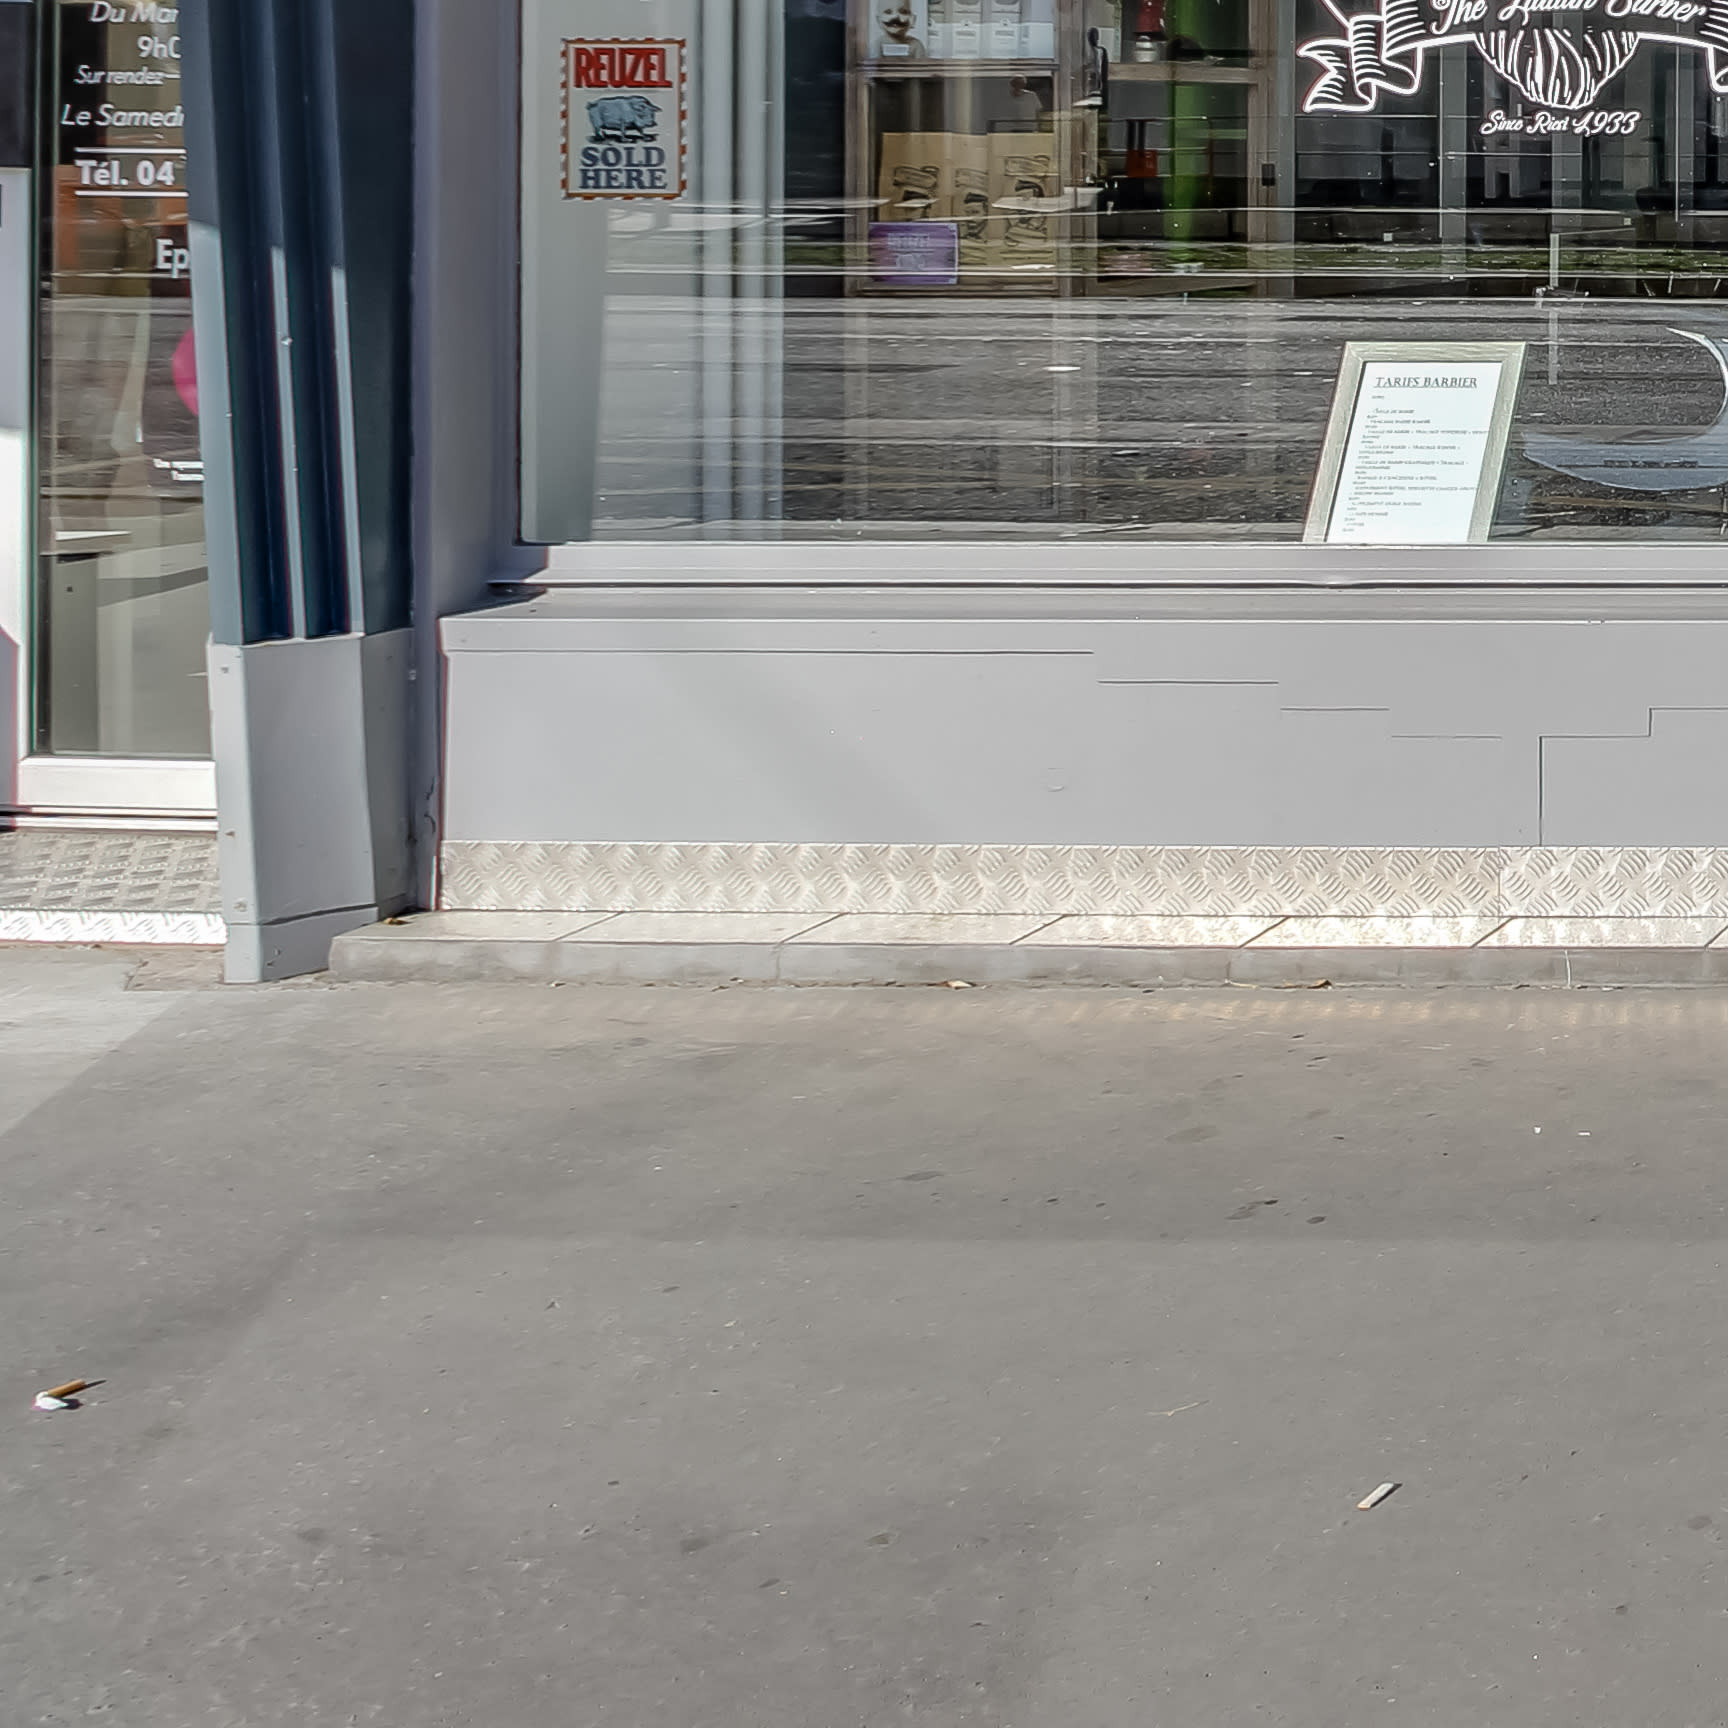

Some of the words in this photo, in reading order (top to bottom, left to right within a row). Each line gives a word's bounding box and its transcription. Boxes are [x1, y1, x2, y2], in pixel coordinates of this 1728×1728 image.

[90, 1, 125, 22] Du
[74, 64, 104, 84] Sur
[573, 47, 673, 88] REUZEL
[61, 104, 91, 126] Le
[581, 146, 665, 168] SOLD
[74, 159, 129, 186] Tél.
[136, 159, 175, 186] 04
[579, 168, 668, 190] HERE
[1374, 377, 1421, 388] TARIFS
[1423, 377, 1478, 388] BARBIER
